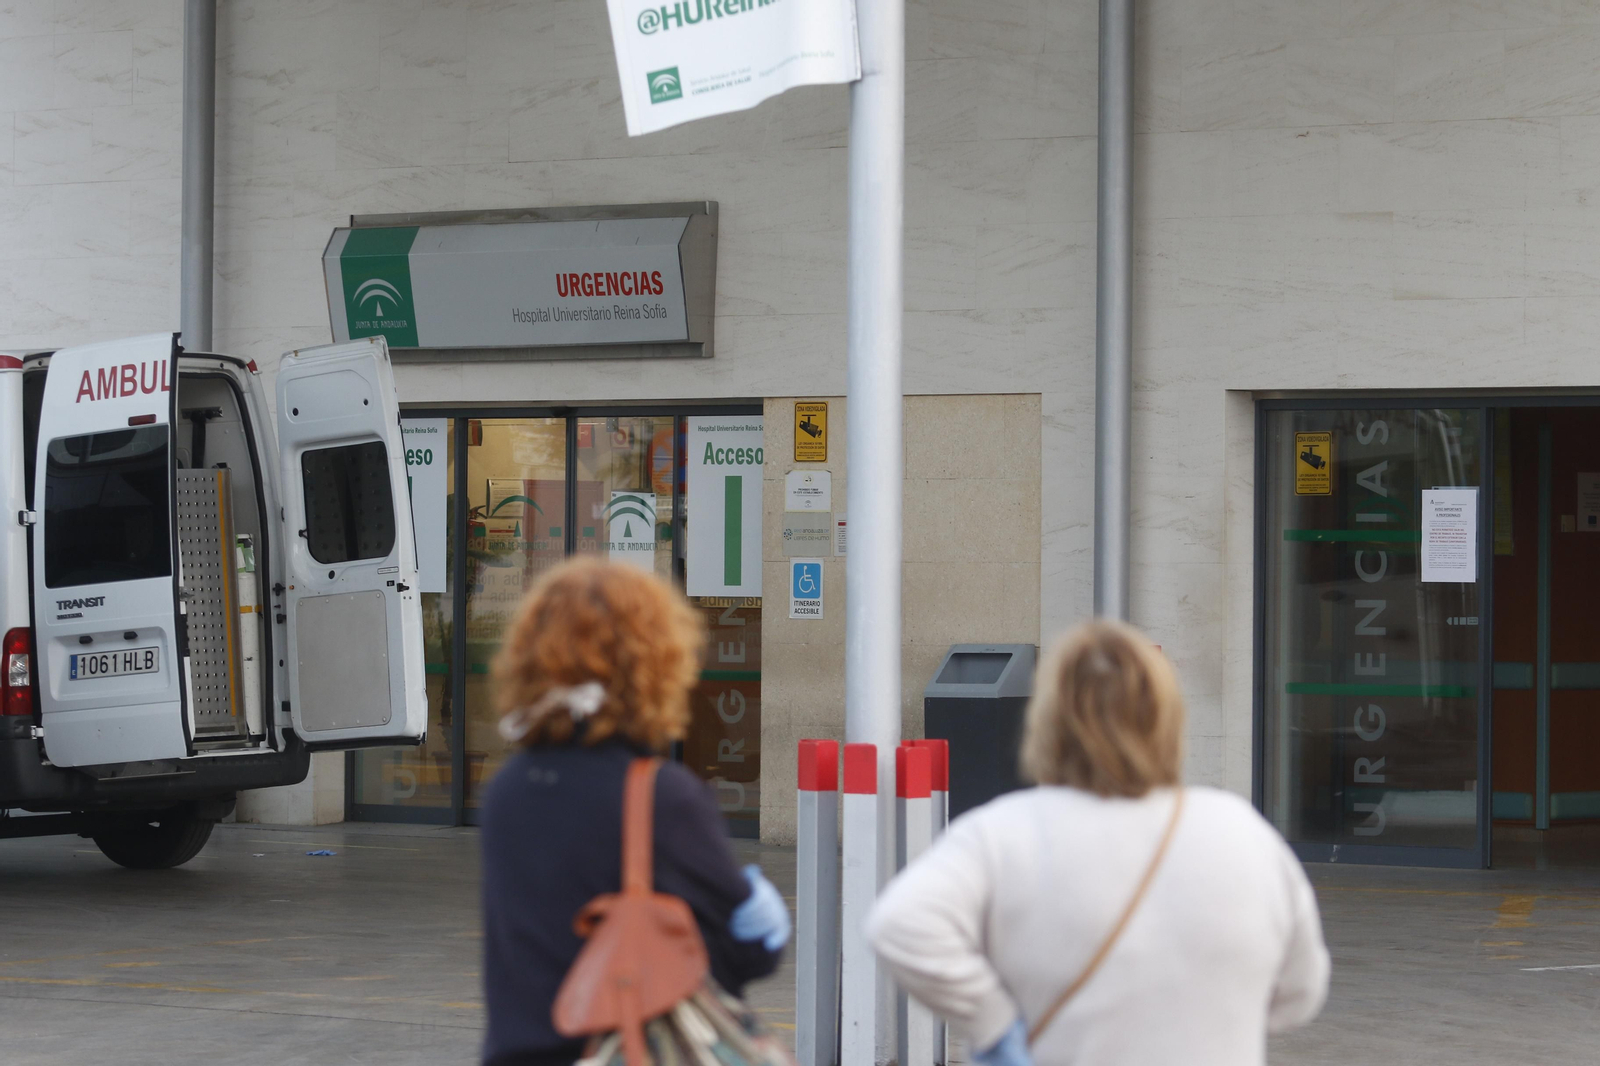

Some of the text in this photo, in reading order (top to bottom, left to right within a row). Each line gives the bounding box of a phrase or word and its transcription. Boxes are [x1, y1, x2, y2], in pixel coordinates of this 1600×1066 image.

[555, 270, 664, 297] URGENCIAS
[355, 320, 371, 329] JUNTA
[372, 320, 379, 328] DE
[512, 303, 668, 325] Hospital Universitario Reina Sofía
[698, 425, 716, 433] Hospital
[716, 424, 745, 432] Universitario
[745, 424, 758, 432] Reina
[703, 441, 764, 465] Acceso
[618, 542, 625, 551] DE
[56, 595, 106, 611] TRANSIT
[1353, 419, 1390, 837] URGENCIAS
[80, 650, 155, 676] 1061 HLB
